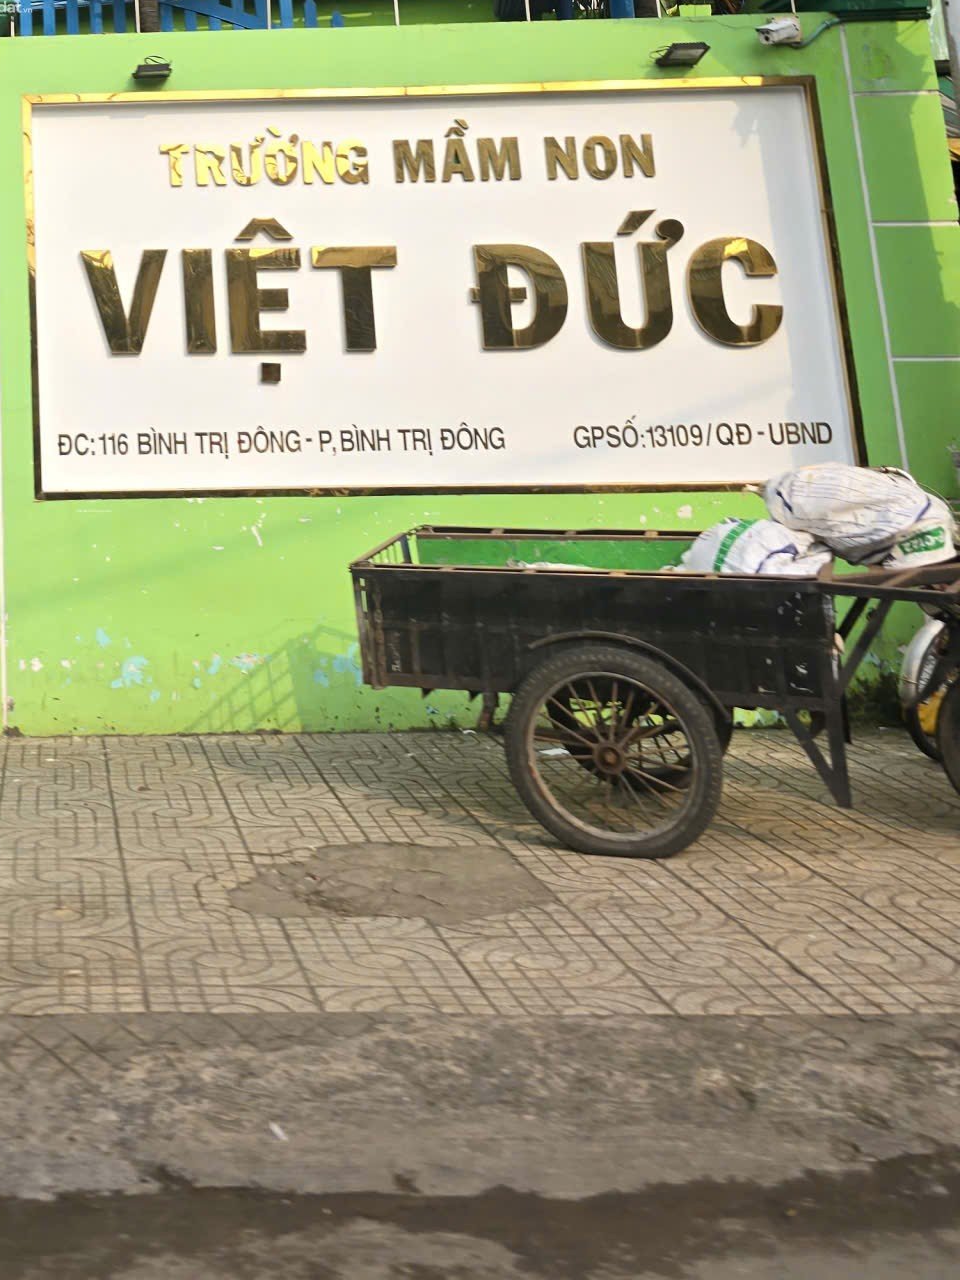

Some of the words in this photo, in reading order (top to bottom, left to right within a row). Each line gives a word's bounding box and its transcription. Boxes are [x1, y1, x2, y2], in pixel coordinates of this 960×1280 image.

[159, 125, 369, 186] TRƯỜNG
[392, 118, 522, 183] MẦM
[543, 134, 657, 180] NON
[79, 217, 398, 385] VIỆT
[469, 208, 784, 351] ĐỨC
[137, 427, 188, 455] BÌNH
[194, 431, 230, 460] TRỊ
[397, 428, 433, 456] TRỊ
[440, 421, 506, 451] ĐÔNG
